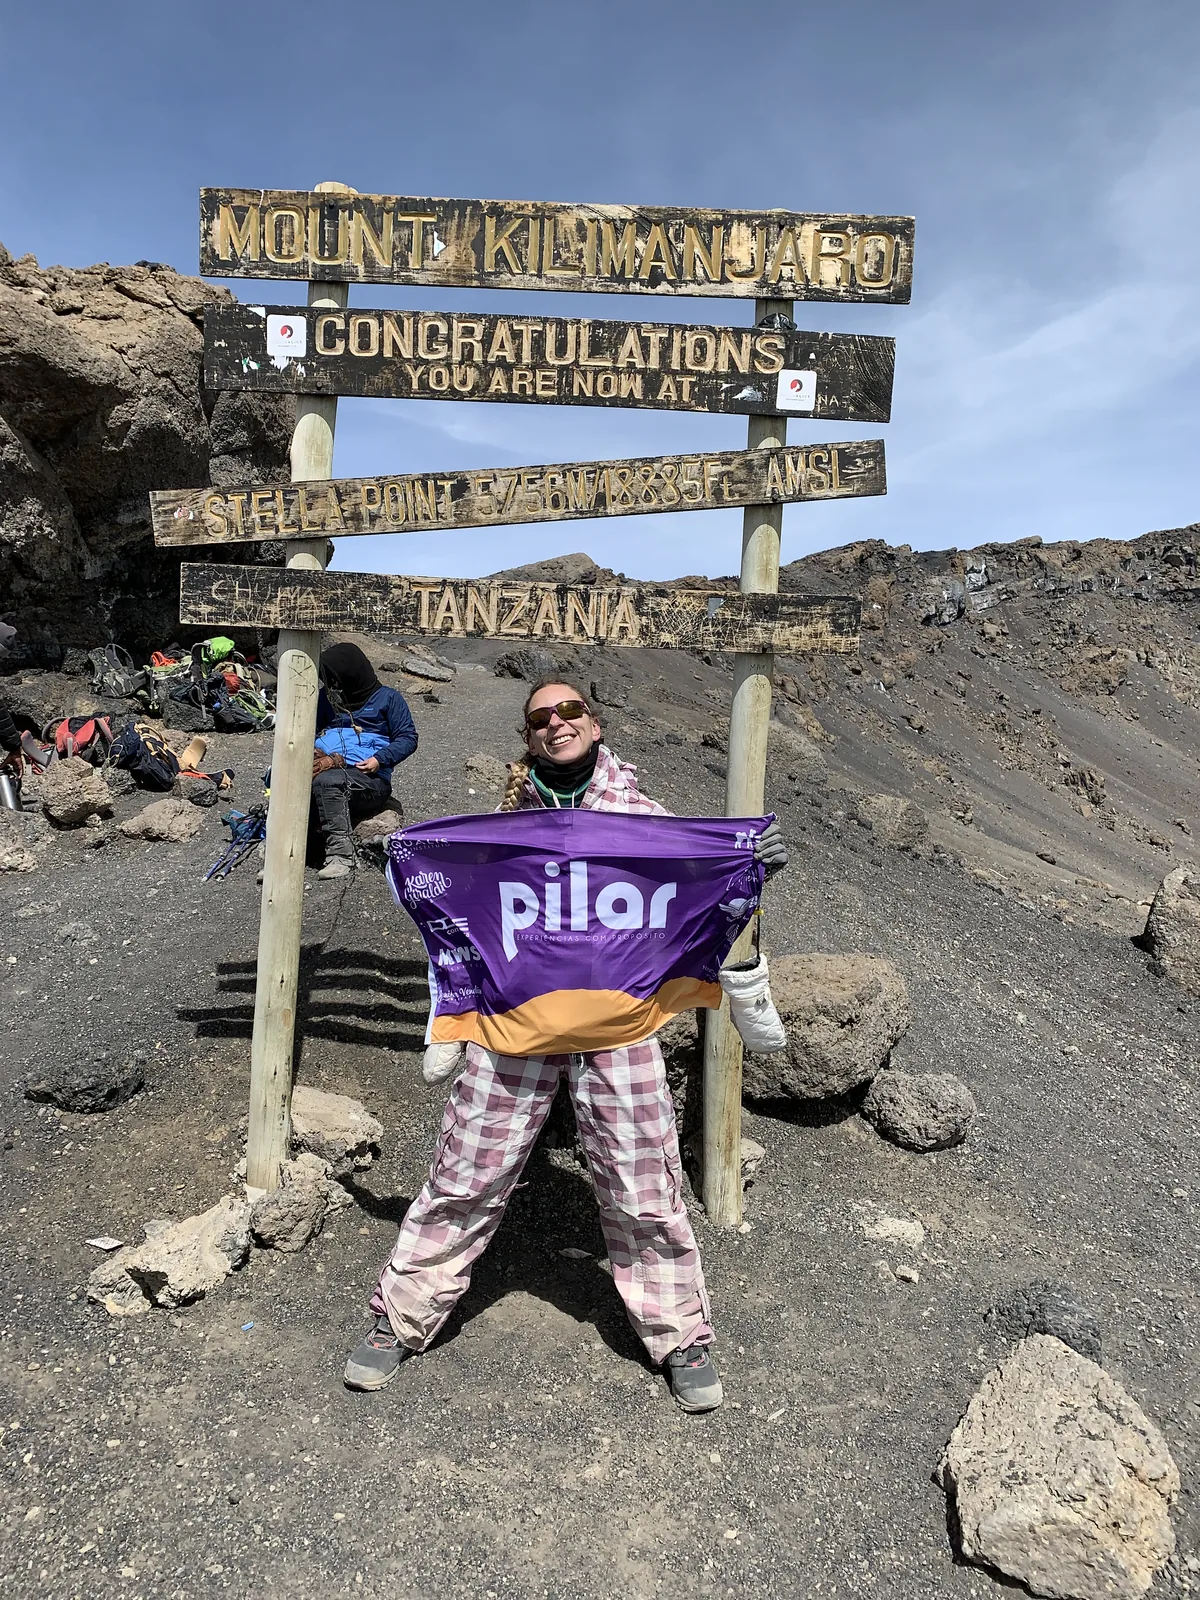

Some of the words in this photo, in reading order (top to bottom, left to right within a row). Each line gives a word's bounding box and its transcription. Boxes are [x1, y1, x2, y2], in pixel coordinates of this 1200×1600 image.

[219, 203, 438, 269] MOUNT
[484, 214, 894, 288] KILIMANJARO
[315, 312, 786, 374] CONGRATULATIONS
[405, 363, 475, 391] YOU
[487, 366, 558, 395] ARE
[572, 369, 643, 399] NOW
[657, 375, 696, 402] AT
[204, 485, 348, 537] STELLA
[361, 478, 458, 530] POINT
[766, 449, 854, 497] AMSL
[412, 583, 641, 640] TANZANIA
[404, 870, 452, 892] Karen
[499, 861, 677, 963] pilar
[585, 934, 607, 942] COM
[438, 945, 481, 967] MWS
